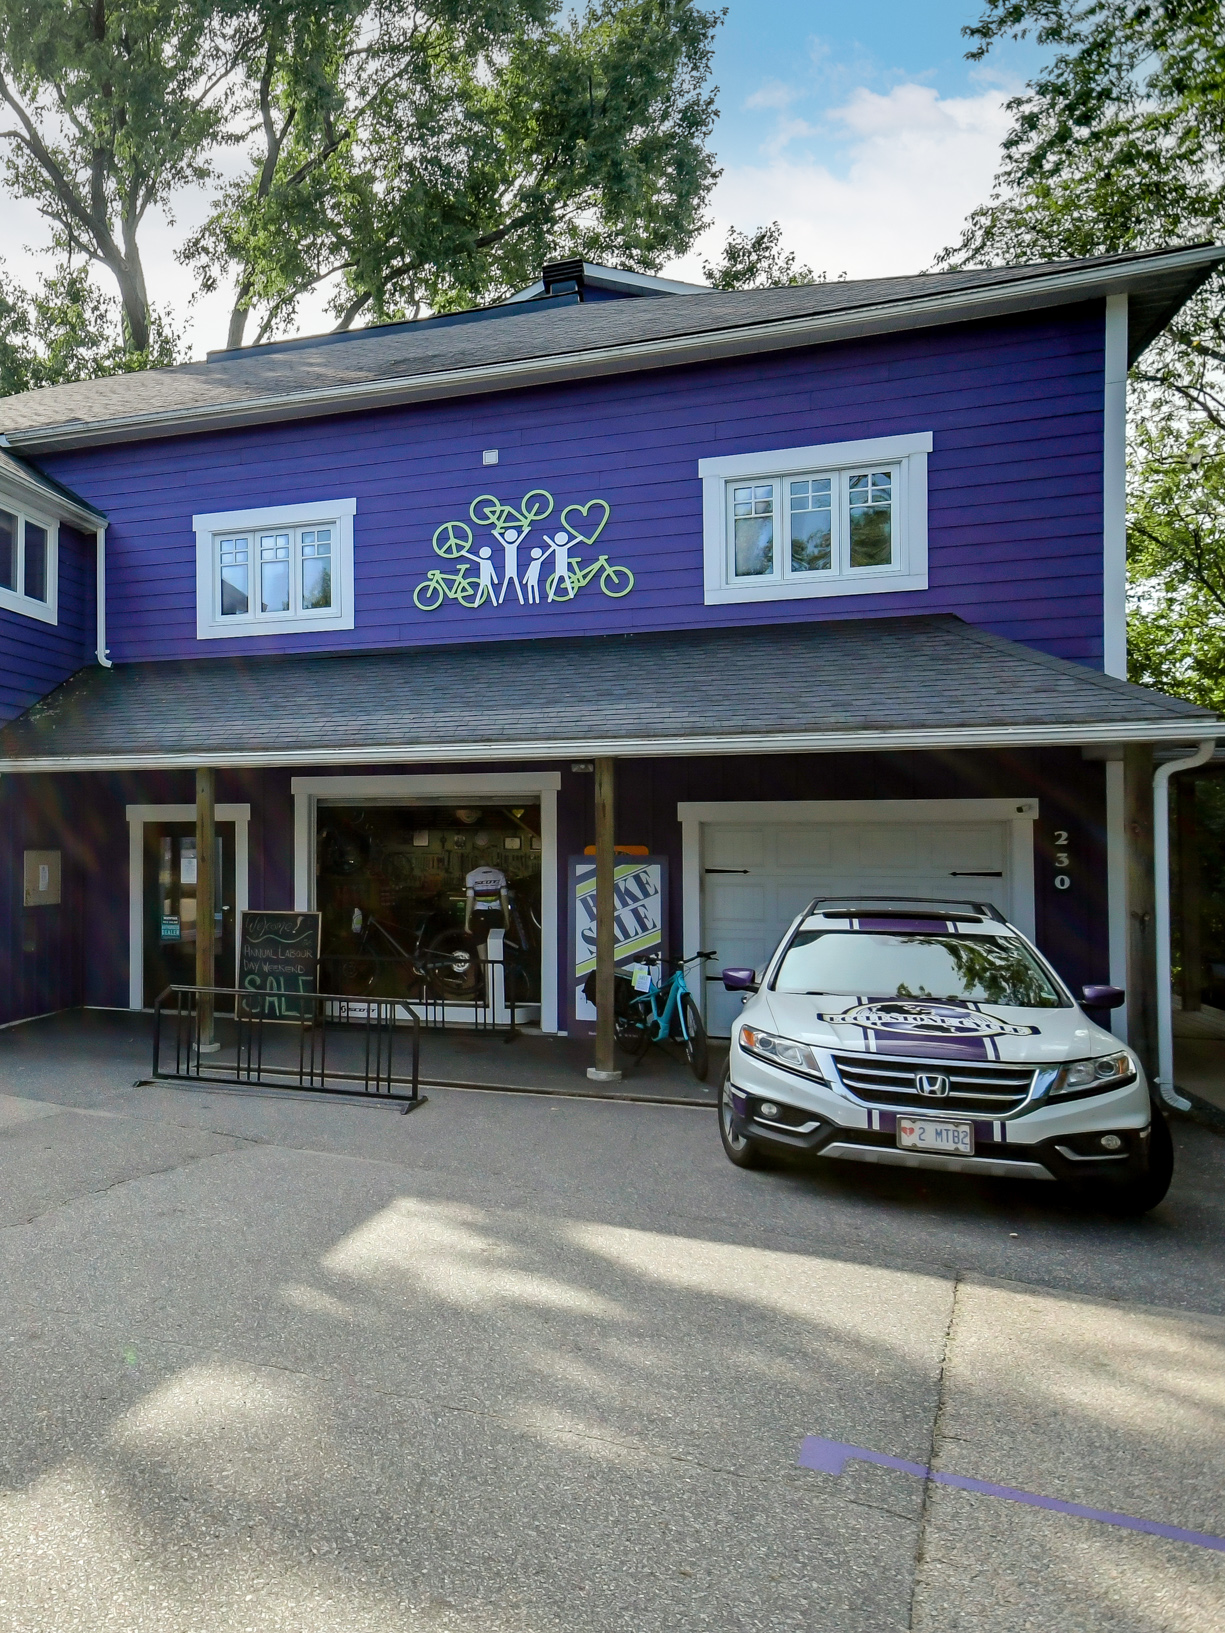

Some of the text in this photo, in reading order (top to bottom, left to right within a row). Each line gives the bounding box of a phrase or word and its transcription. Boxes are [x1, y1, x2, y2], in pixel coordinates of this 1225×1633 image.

[578, 869, 659, 923] BKE
[242, 975, 313, 1018] SALE
[829, 1014, 1025, 1034] ECCLESTONE CYCLE
[918, 1126, 969, 1146] 2 MTB2
